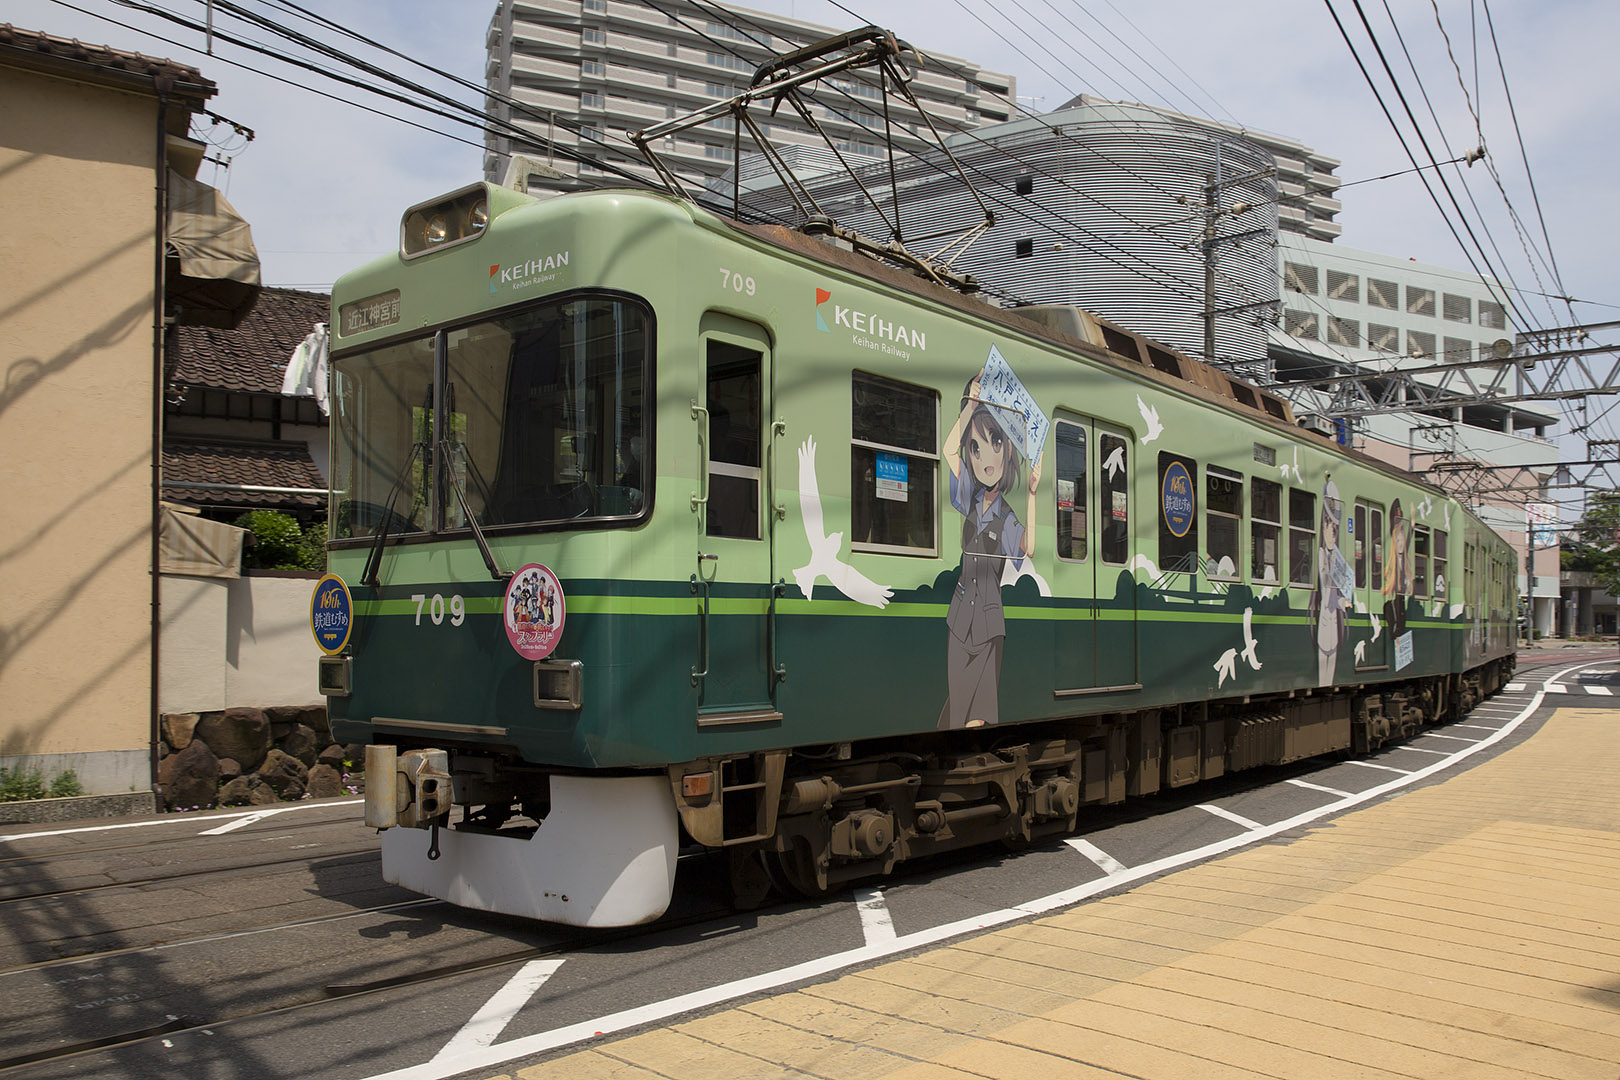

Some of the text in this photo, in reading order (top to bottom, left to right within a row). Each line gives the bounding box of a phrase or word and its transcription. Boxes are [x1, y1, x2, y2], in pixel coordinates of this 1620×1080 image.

[501, 251, 569, 283] KEIHAN
[512, 273, 556, 290] Keihan Railway
[719, 267, 756, 297] 709
[348, 296, 401, 331] 近江神宮前
[834, 304, 926, 351] KEIHAN
[852, 334, 911, 362] Keihan Railway
[314, 610, 349, 632] 鉄道むすめ
[411, 593, 465, 627] 709
